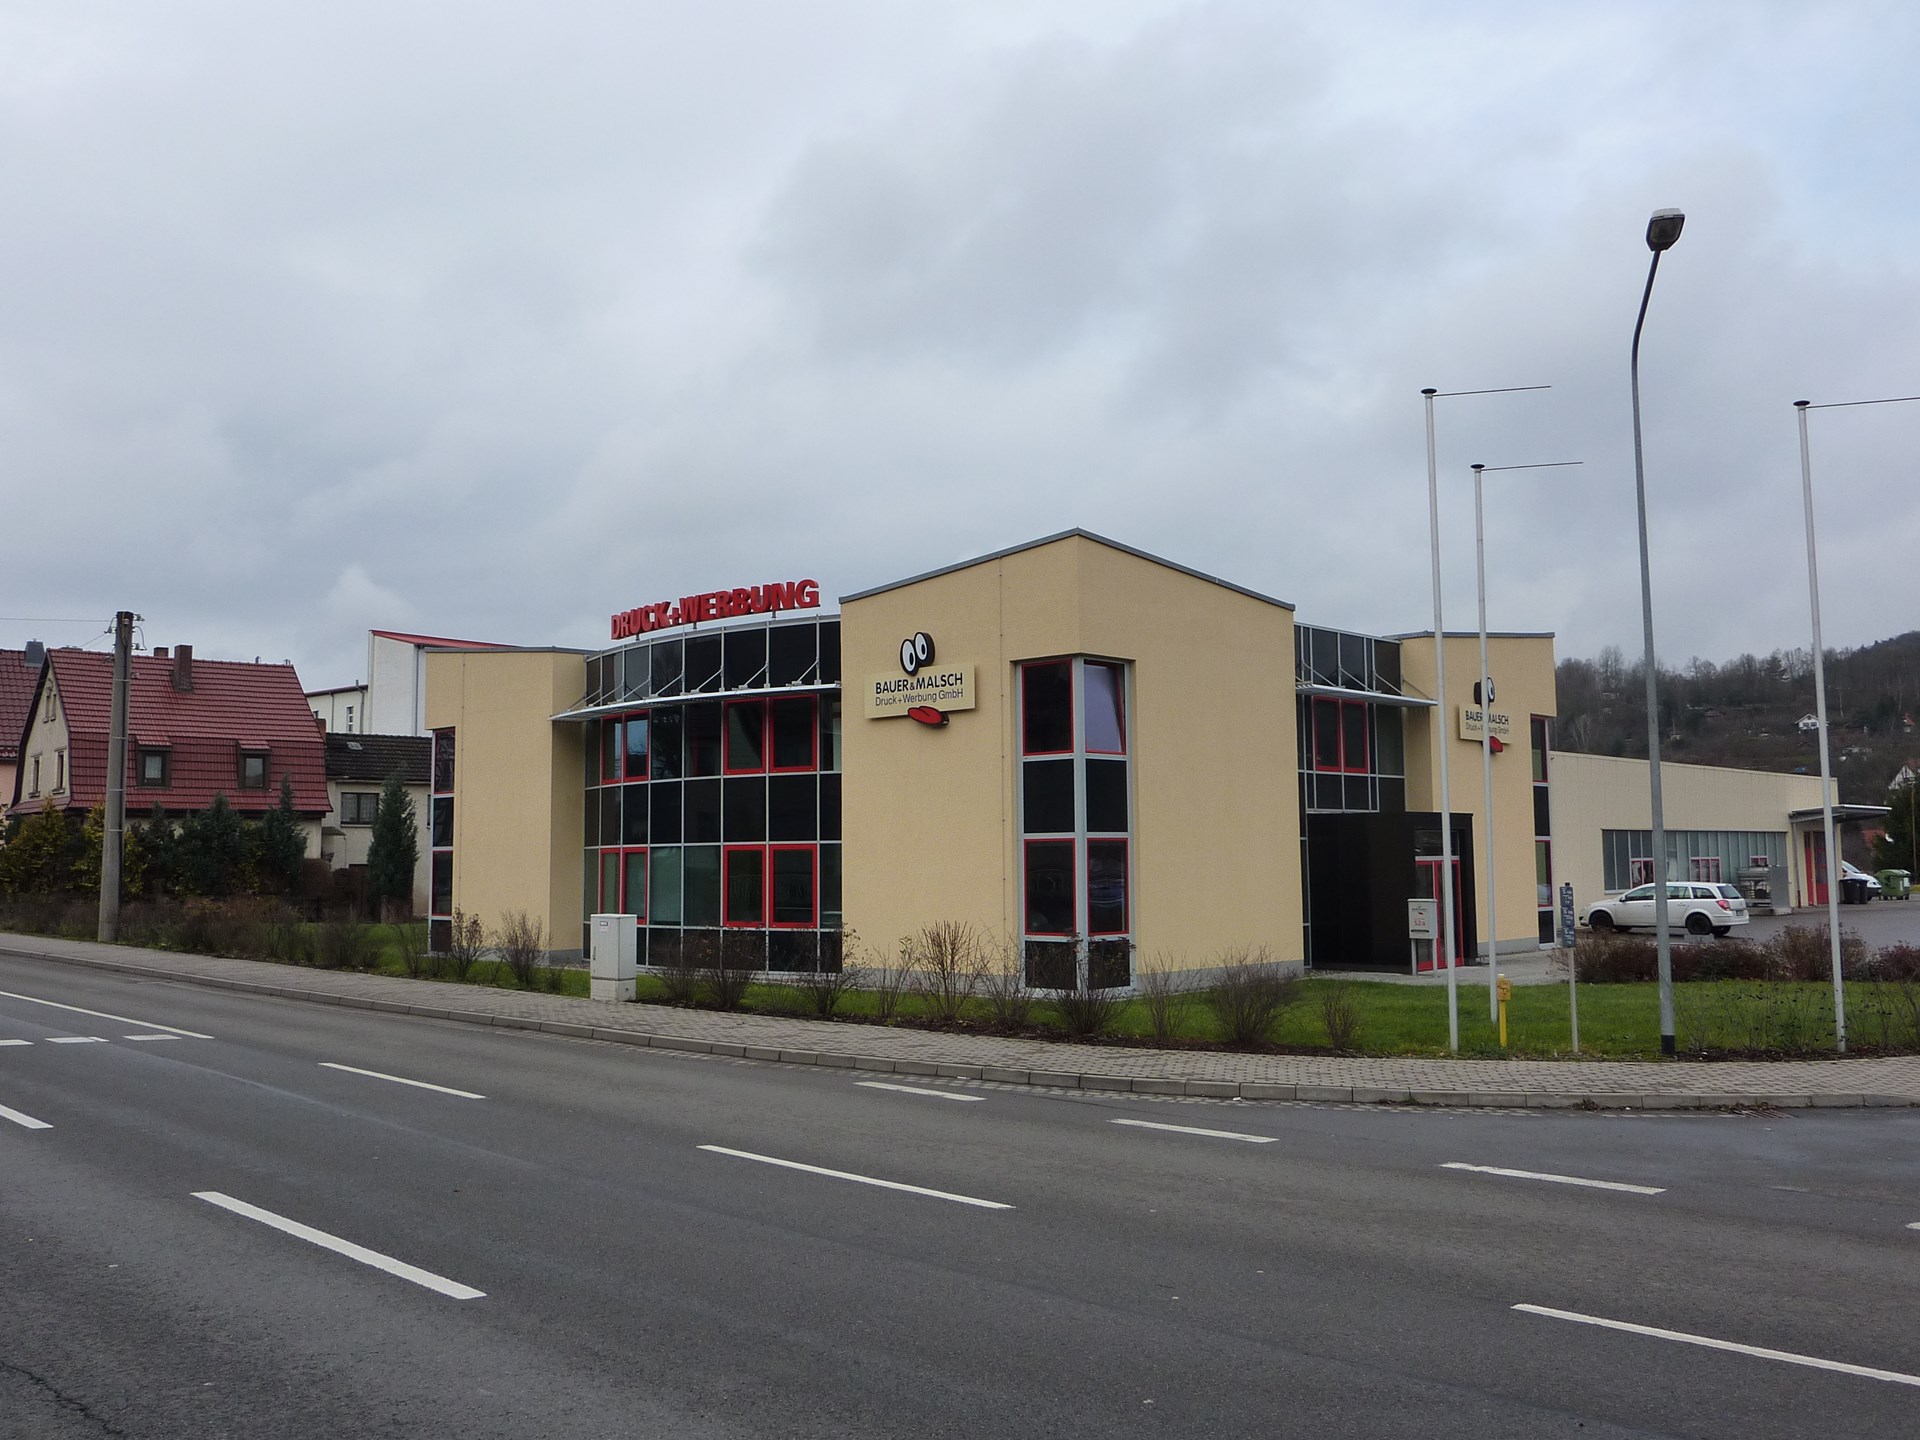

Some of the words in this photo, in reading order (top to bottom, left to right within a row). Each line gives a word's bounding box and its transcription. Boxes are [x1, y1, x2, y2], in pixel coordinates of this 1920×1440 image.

[611, 579, 820, 640] DRUCK+WERBUNG
[875, 672, 963, 695] BAUER&MALSCH
[875, 692, 937, 707] Druck+Werbung
[938, 688, 964, 700] GmbH
